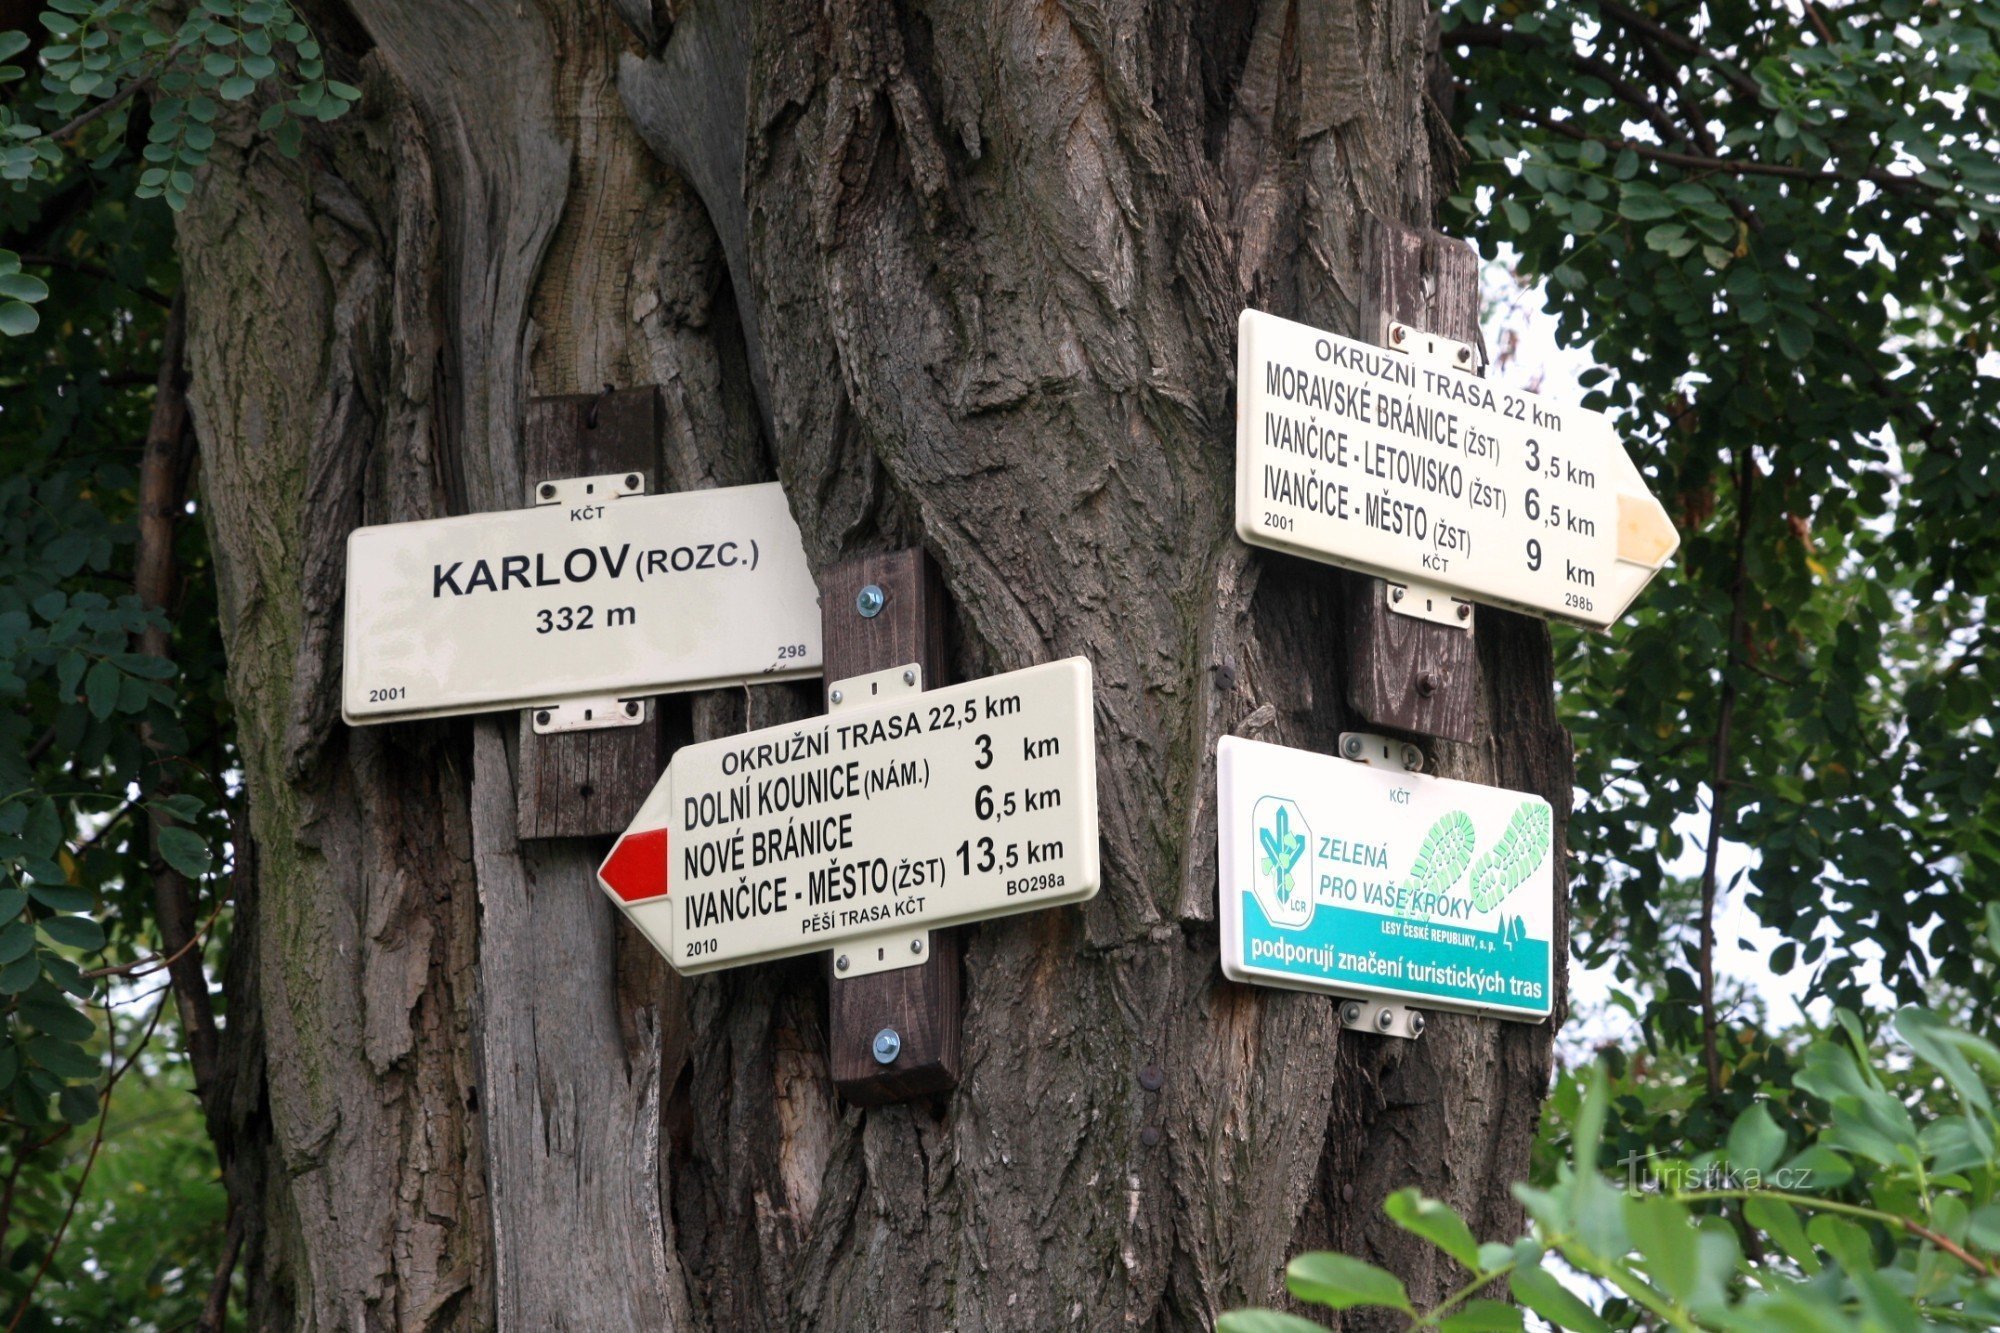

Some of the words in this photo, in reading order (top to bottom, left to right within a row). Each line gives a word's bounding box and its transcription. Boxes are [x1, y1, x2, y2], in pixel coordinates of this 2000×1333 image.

[1315, 339, 1415, 387] OKRUŽNÍ
[1423, 369, 1496, 412] TRASA
[1503, 396, 1526, 421] 22
[1533, 403, 1561, 432] km
[1266, 361, 1371, 423] MORAVSKÉ
[1378, 394, 1458, 448] BRÁNICE
[1464, 426, 1500, 466] (ŽST)
[1525, 439, 1561, 480] 3,5
[1567, 461, 1595, 489] km
[1265, 412, 1348, 467] IVANČICE
[1365, 440, 1462, 498] LETOVISKO
[1469, 477, 1506, 517] (ŽST)
[1525, 488, 1561, 529] 6,5
[1567, 509, 1595, 537] km
[570, 506, 605, 521] KČT
[1264, 512, 1294, 531] 2001
[1264, 464, 1348, 519] IVANČICE
[1365, 489, 1427, 540] MĚSTO
[1434, 518, 1471, 558] (ŽST)
[1526, 539, 1542, 572] 9
[1567, 560, 1595, 587] km
[433, 543, 630, 598] KARLOV
[635, 539, 759, 582] (ROZC.)
[1422, 554, 1449, 572] KČT
[536, 604, 593, 634] 332
[606, 606, 636, 626] m
[1565, 593, 1593, 611] 298b
[777, 644, 806, 660] 298
[369, 687, 406, 702] 2001
[722, 725, 829, 775] OKRUŽNÍ
[837, 712, 922, 751] TRASA
[928, 700, 977, 731] 22,5
[986, 695, 1021, 719] km
[684, 776, 751, 830] DOLNÍ
[759, 762, 860, 813] KOUNICE
[864, 759, 929, 799] (NÁM.)
[974, 734, 994, 769] 3
[1024, 734, 1060, 761] km
[1390, 787, 1410, 805] KČT
[684, 827, 745, 880] NOVÉ
[753, 814, 853, 866] BRÁNICE
[974, 785, 1016, 821] 6,5
[1025, 787, 1061, 812] km
[1319, 837, 1388, 869] ZELENÁ
[685, 877, 788, 930] IVANČICE
[809, 858, 887, 906] MĚSTO
[892, 858, 945, 896] (ŽST)
[956, 837, 1019, 876] 13,5
[1027, 840, 1064, 865] km
[1006, 874, 1065, 896] BO298a
[1320, 875, 1357, 900] PRO
[1364, 880, 1406, 910] VAŠE
[1413, 890, 1474, 920] KROKY
[802, 912, 835, 934] PĚŠÍ
[839, 906, 891, 926] TRASA
[894, 898, 926, 917] KČT
[686, 938, 718, 957] 2010
[1381, 920, 1401, 936] LESY
[1403, 919, 1429, 941] ČESKÉ
[1431, 929, 1477, 949] REPUBLIKY,
[1251, 936, 1334, 971] podporují
[1338, 950, 1402, 978] značení
[1407, 960, 1504, 995] turistických
[1510, 976, 1542, 999] tras
